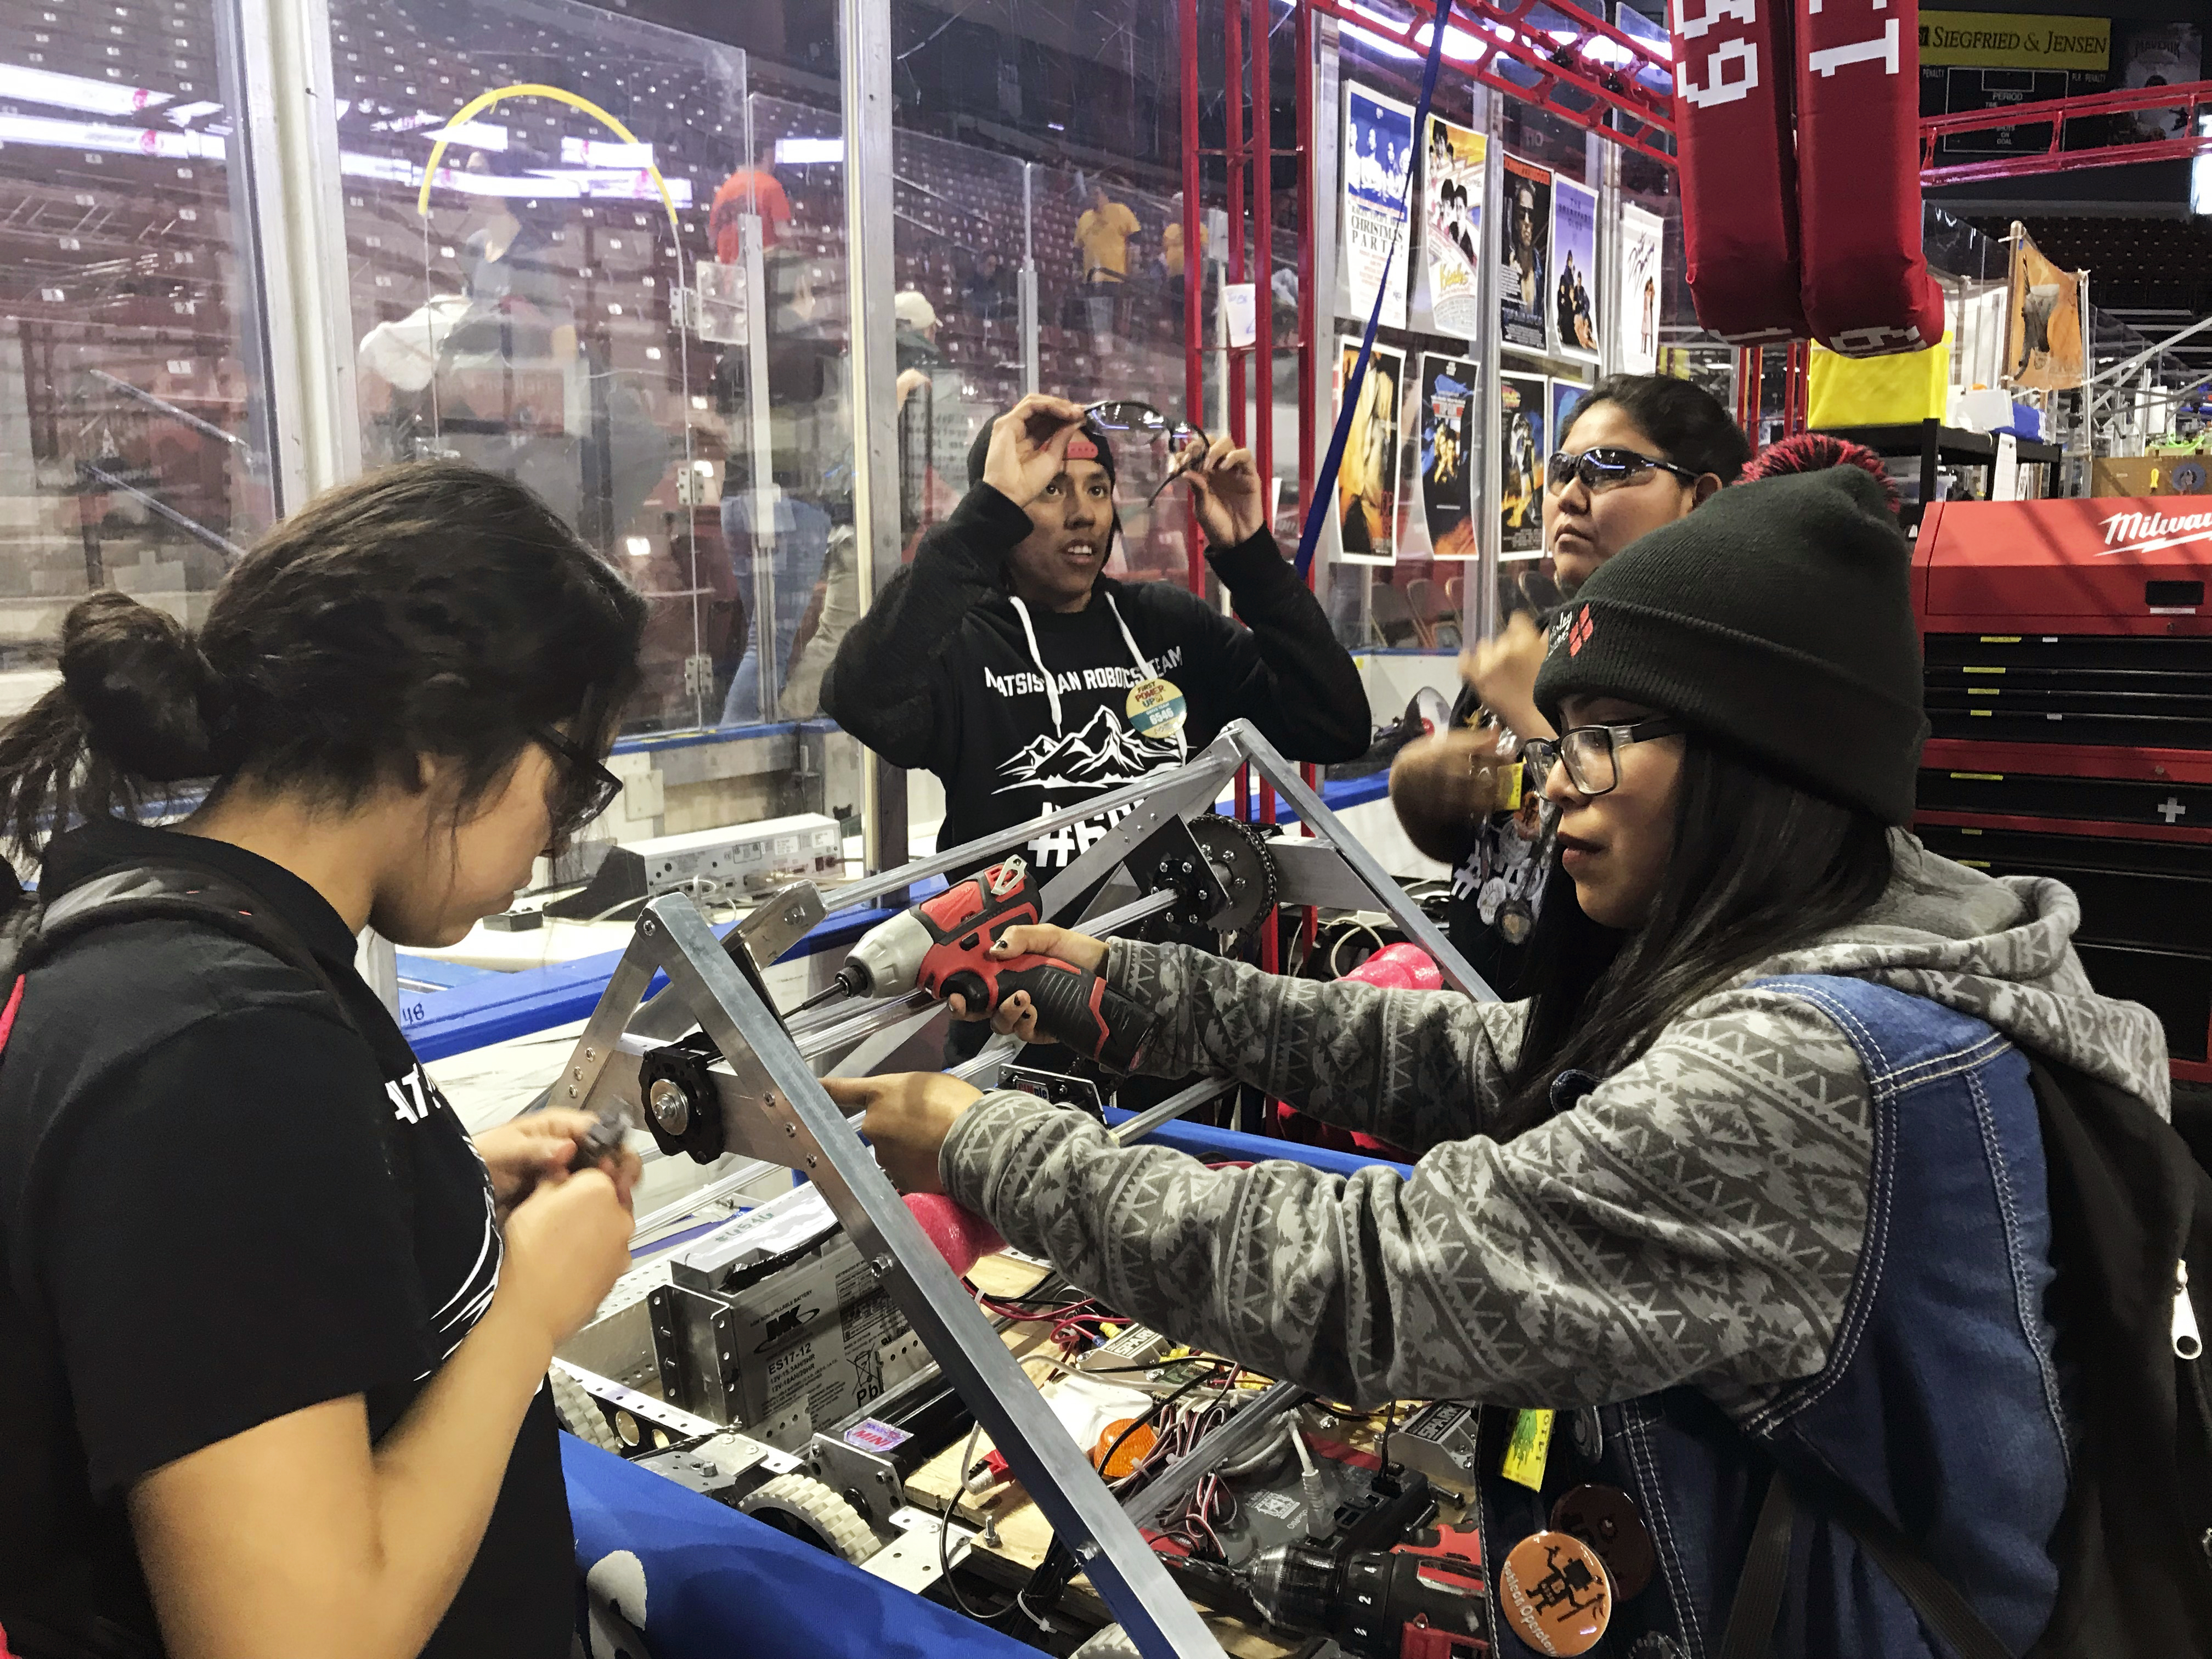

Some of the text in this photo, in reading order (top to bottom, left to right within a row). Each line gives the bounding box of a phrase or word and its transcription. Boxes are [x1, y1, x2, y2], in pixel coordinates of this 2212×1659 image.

[1932, 26, 2021, 50] SIEGFRIED
[2023, 34, 2040, 52] &
[2044, 30, 2108, 54] JENSEN
[1923, 69, 1945, 78] PENALTY
[2085, 73, 2107, 83] PENALTY
[1993, 92, 2023, 101] PERIOD
[1351, 215, 1403, 243] CHRISTMAS
[1352, 229, 1403, 258] PART!
[1135, 685, 1165, 703] POWER
[1137, 681, 1156, 692] FIRST
[1149, 707, 1174, 725] 6546
[793, 1289, 812, 1304] BATTERY
[766, 1304, 803, 1342] MK
[1114, 1329, 1155, 1355] SPARK
[769, 1342, 811, 1375] ES17-12
[856, 1384, 878, 1408] Pb
[854, 1430, 893, 1447] MINI
[1358, 1595, 1372, 1605] 2
